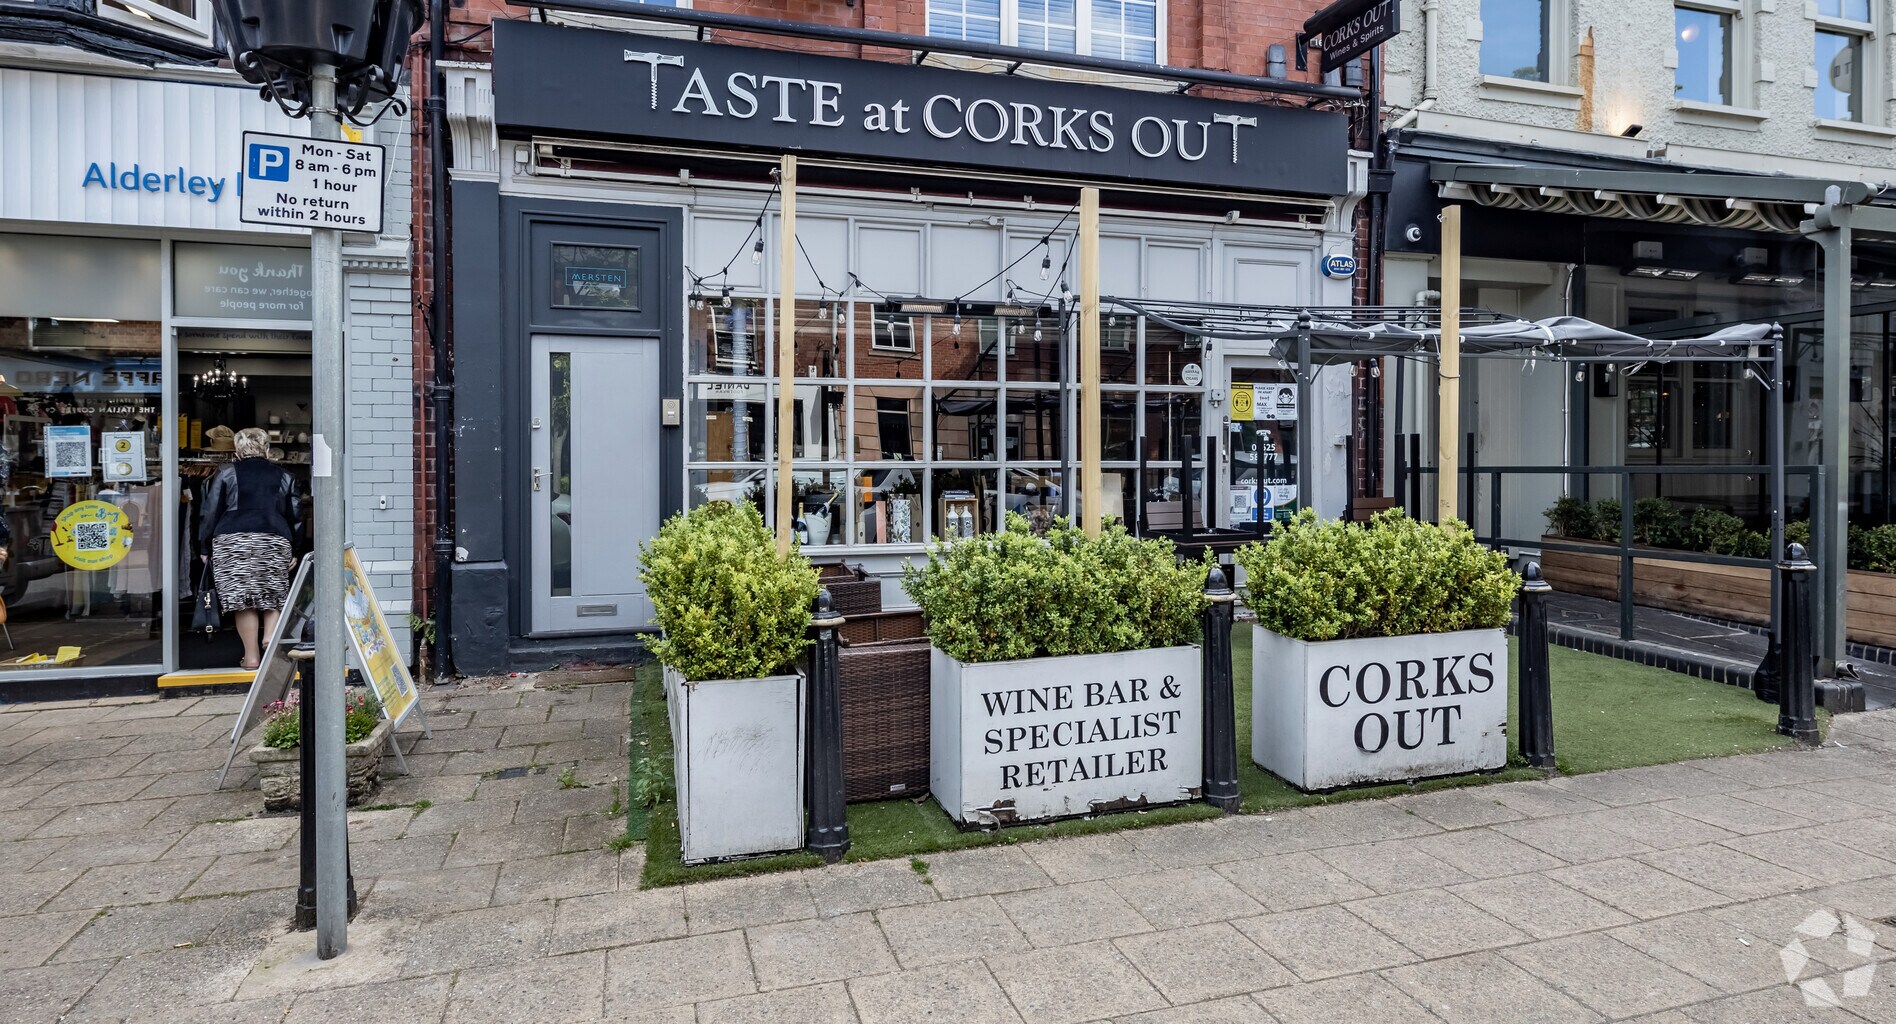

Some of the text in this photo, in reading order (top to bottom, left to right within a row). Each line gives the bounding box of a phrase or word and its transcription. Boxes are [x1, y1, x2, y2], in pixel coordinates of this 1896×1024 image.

[1323, 17, 1361, 52] CORKS
[1329, 24, 1384, 61] Wines & Spirits
[623, 49, 1258, 164] TASTE at CORKS OUT
[258, 148, 284, 177] P
[302, 144, 333, 157] Mon
[345, 149, 371, 162] Sat
[295, 159, 304, 170] 8
[308, 163, 330, 173] am
[342, 164, 351, 174] 6
[354, 167, 376, 177] pm
[82, 162, 226, 203] Alderley
[312, 178, 357, 193] 1 hour
[276, 193, 349, 210] No return
[258, 206, 366, 225] within 2 hours
[1330, 260, 1354, 268] ATLAS
[571, 273, 621, 282] MERSTEN
[1249, 453, 1278, 461] 58777
[1251, 443, 1276, 451] 025
[1240, 477, 1287, 485] corkut.com
[1319, 652, 1494, 708] CORKS
[981, 675, 1182, 717] WINE BAR &
[984, 710, 1181, 755] SPECIALIST
[1354, 705, 1462, 754] OUT
[1000, 748, 1169, 790] RETAILER
